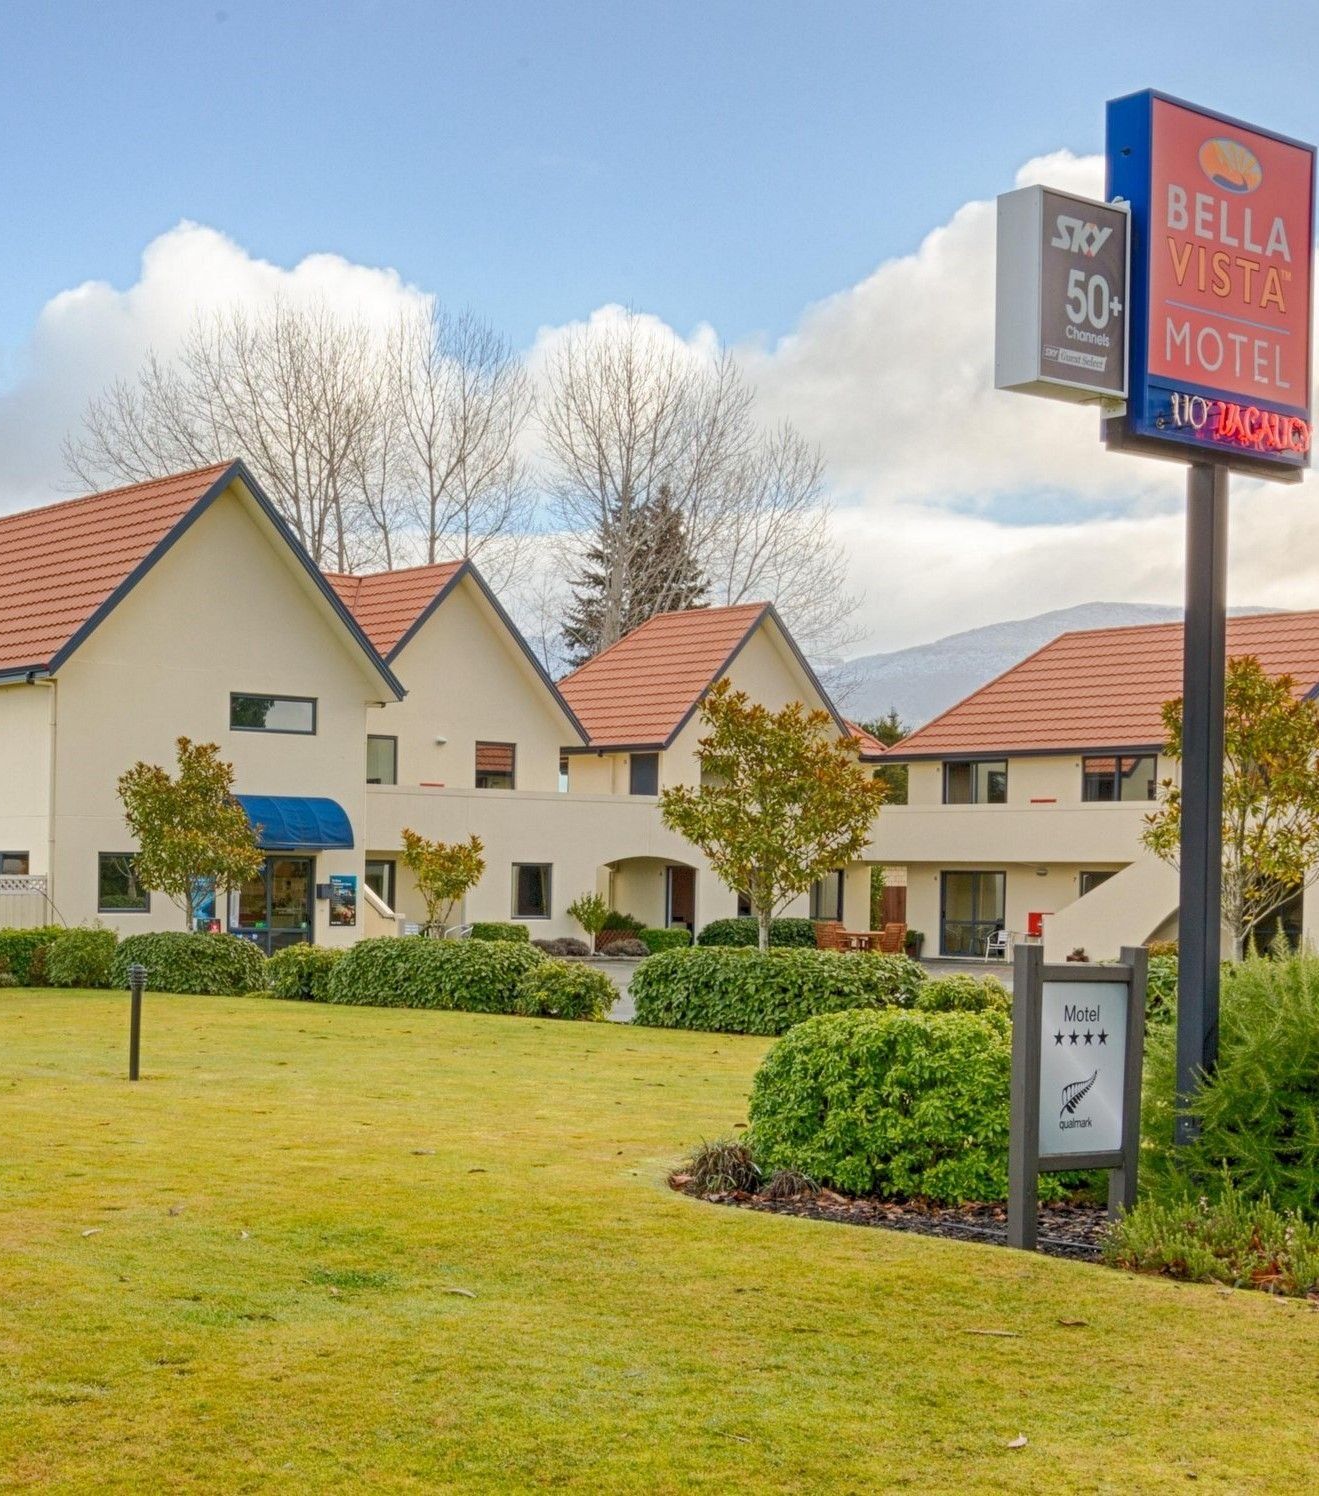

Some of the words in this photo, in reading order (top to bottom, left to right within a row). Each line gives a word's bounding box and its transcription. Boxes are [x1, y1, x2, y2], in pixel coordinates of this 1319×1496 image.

[1051, 215, 1113, 257] SKY
[1167, 184, 1292, 262] BELLA
[1065, 268, 1122, 330] 50+
[1066, 325, 1110, 348] Channels
[1166, 317, 1290, 388] MOTEL
[1064, 1005, 1101, 1023] Motel
[1059, 1116, 1093, 1131] qualmark
